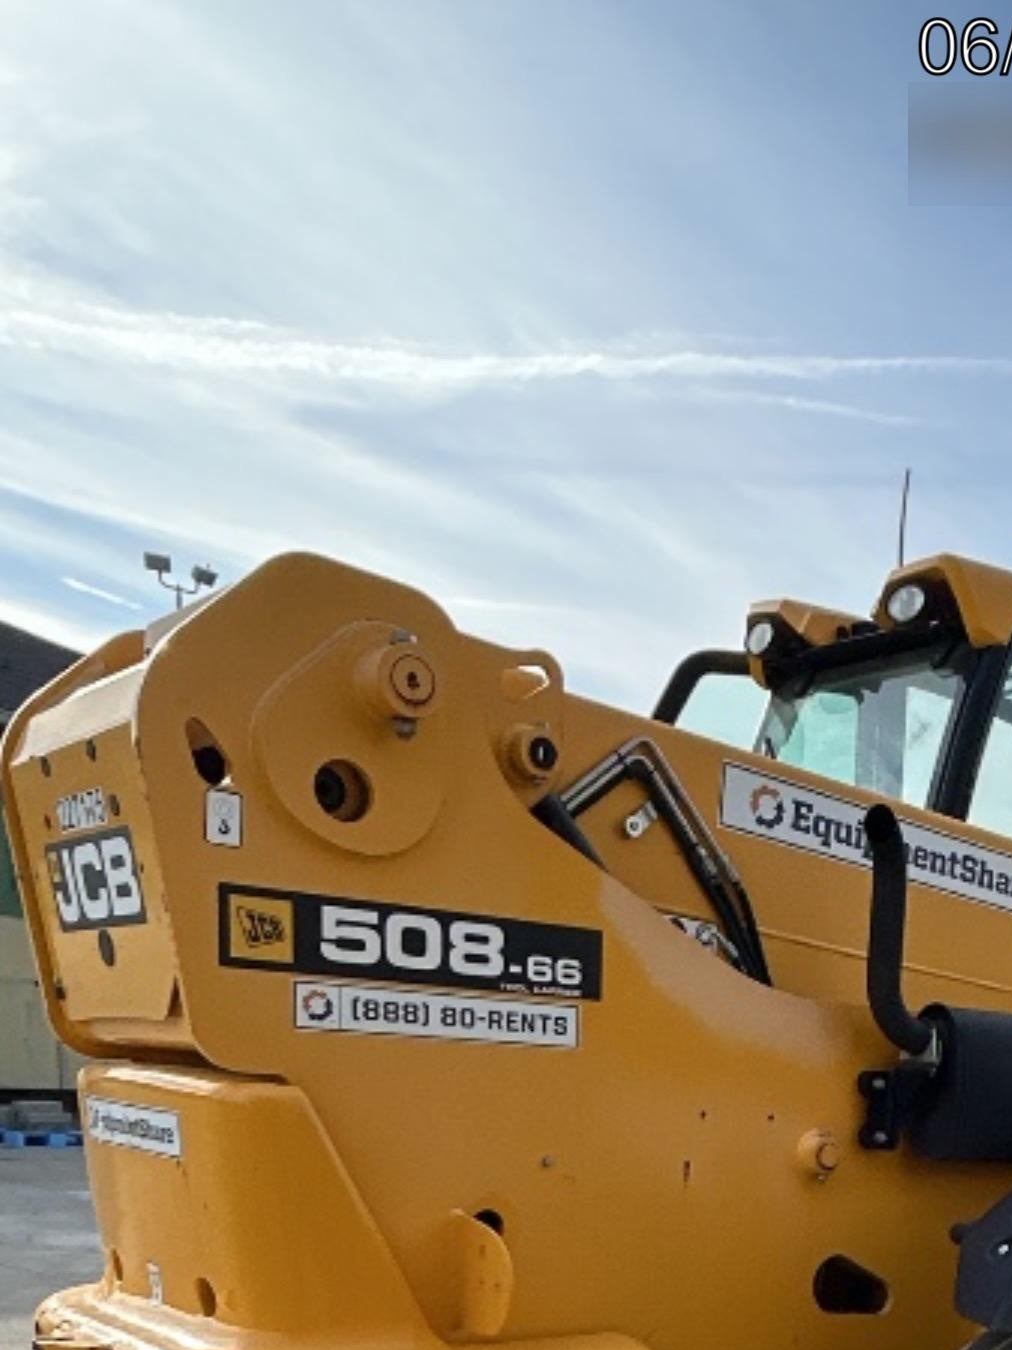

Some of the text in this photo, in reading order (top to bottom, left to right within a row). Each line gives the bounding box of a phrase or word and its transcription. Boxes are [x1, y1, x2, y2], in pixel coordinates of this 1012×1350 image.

[55, 836, 142, 922] JCB
[352, 995, 568, 1036] (888) 80-RENTS
